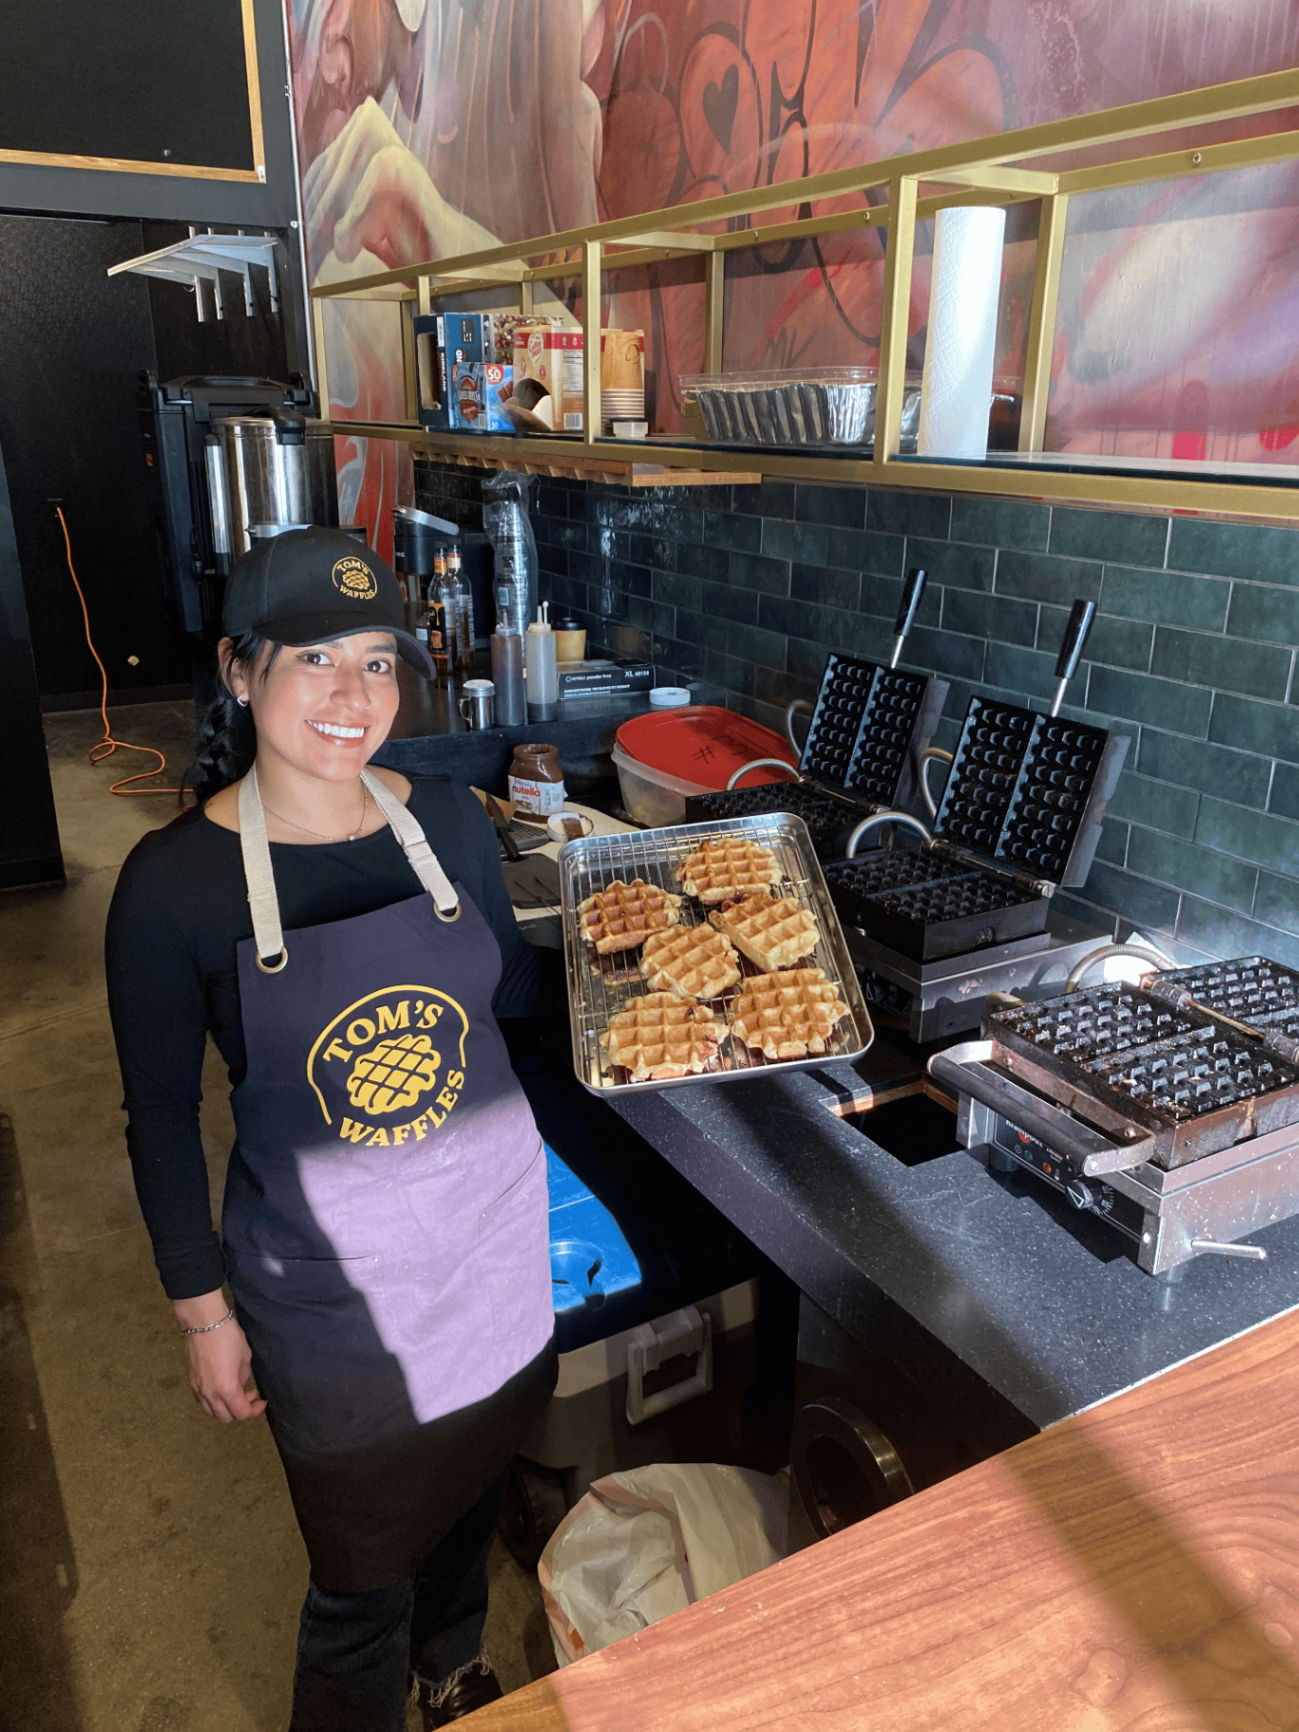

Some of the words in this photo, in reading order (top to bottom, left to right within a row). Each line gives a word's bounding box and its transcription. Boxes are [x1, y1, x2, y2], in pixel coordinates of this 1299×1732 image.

[488, 370, 501, 380] 50
[337, 560, 370, 574] TOM'S
[512, 785, 540, 797] nutella
[322, 1000, 444, 1063] TOM'S
[339, 1069, 465, 1147] WAFFLES
